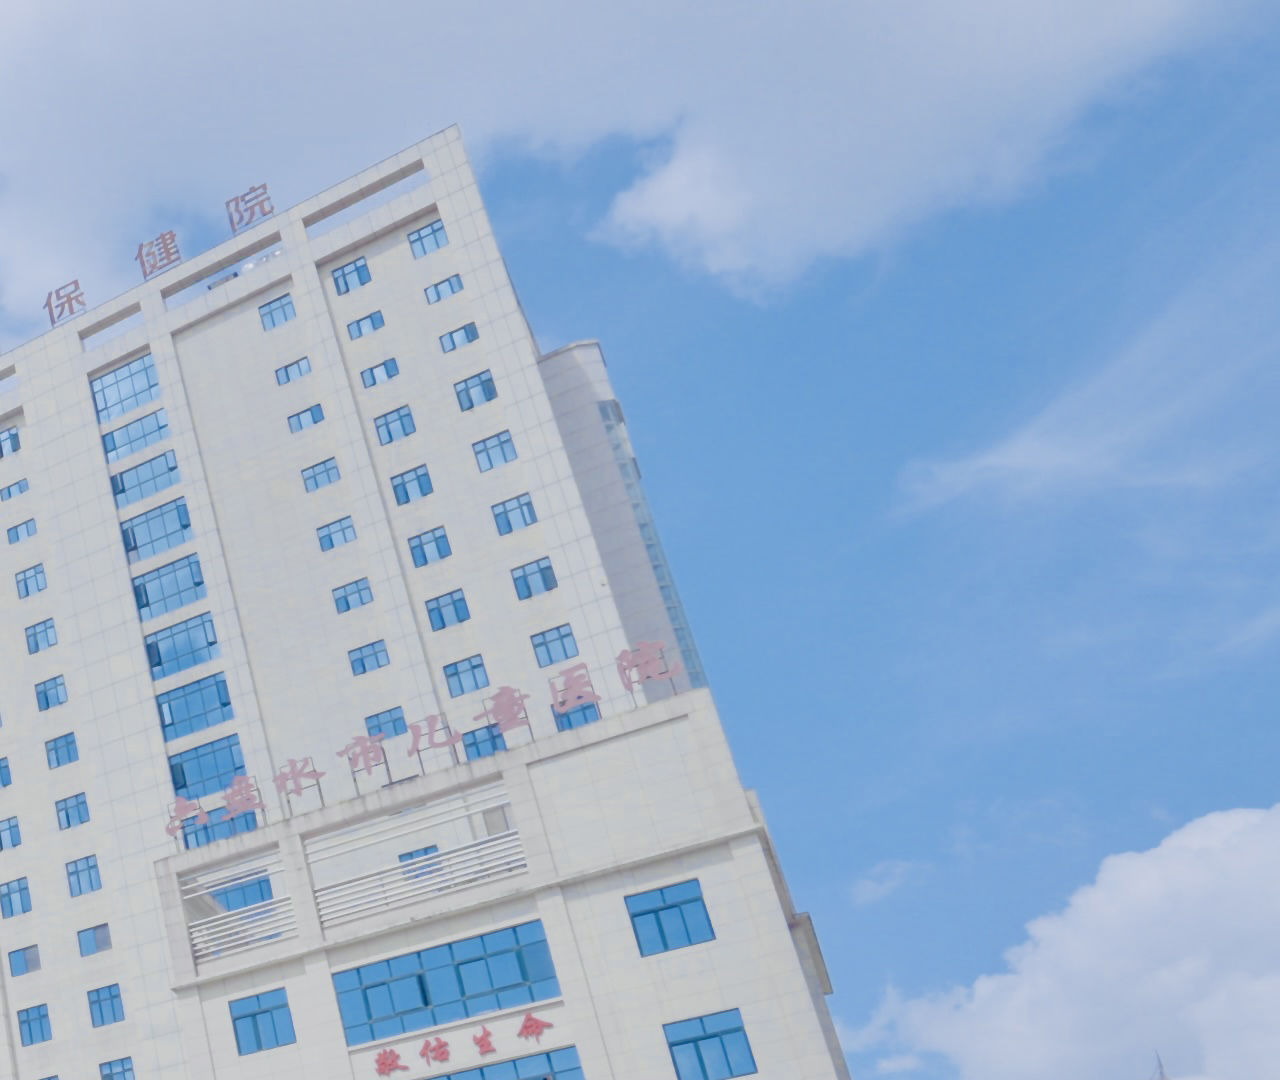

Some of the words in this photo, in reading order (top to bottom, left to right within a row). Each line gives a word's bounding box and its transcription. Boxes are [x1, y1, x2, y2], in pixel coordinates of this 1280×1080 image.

[165, 641, 682, 836] 六盘水市儿童医院
[374, 1012, 554, 1077] 敬佑生命
